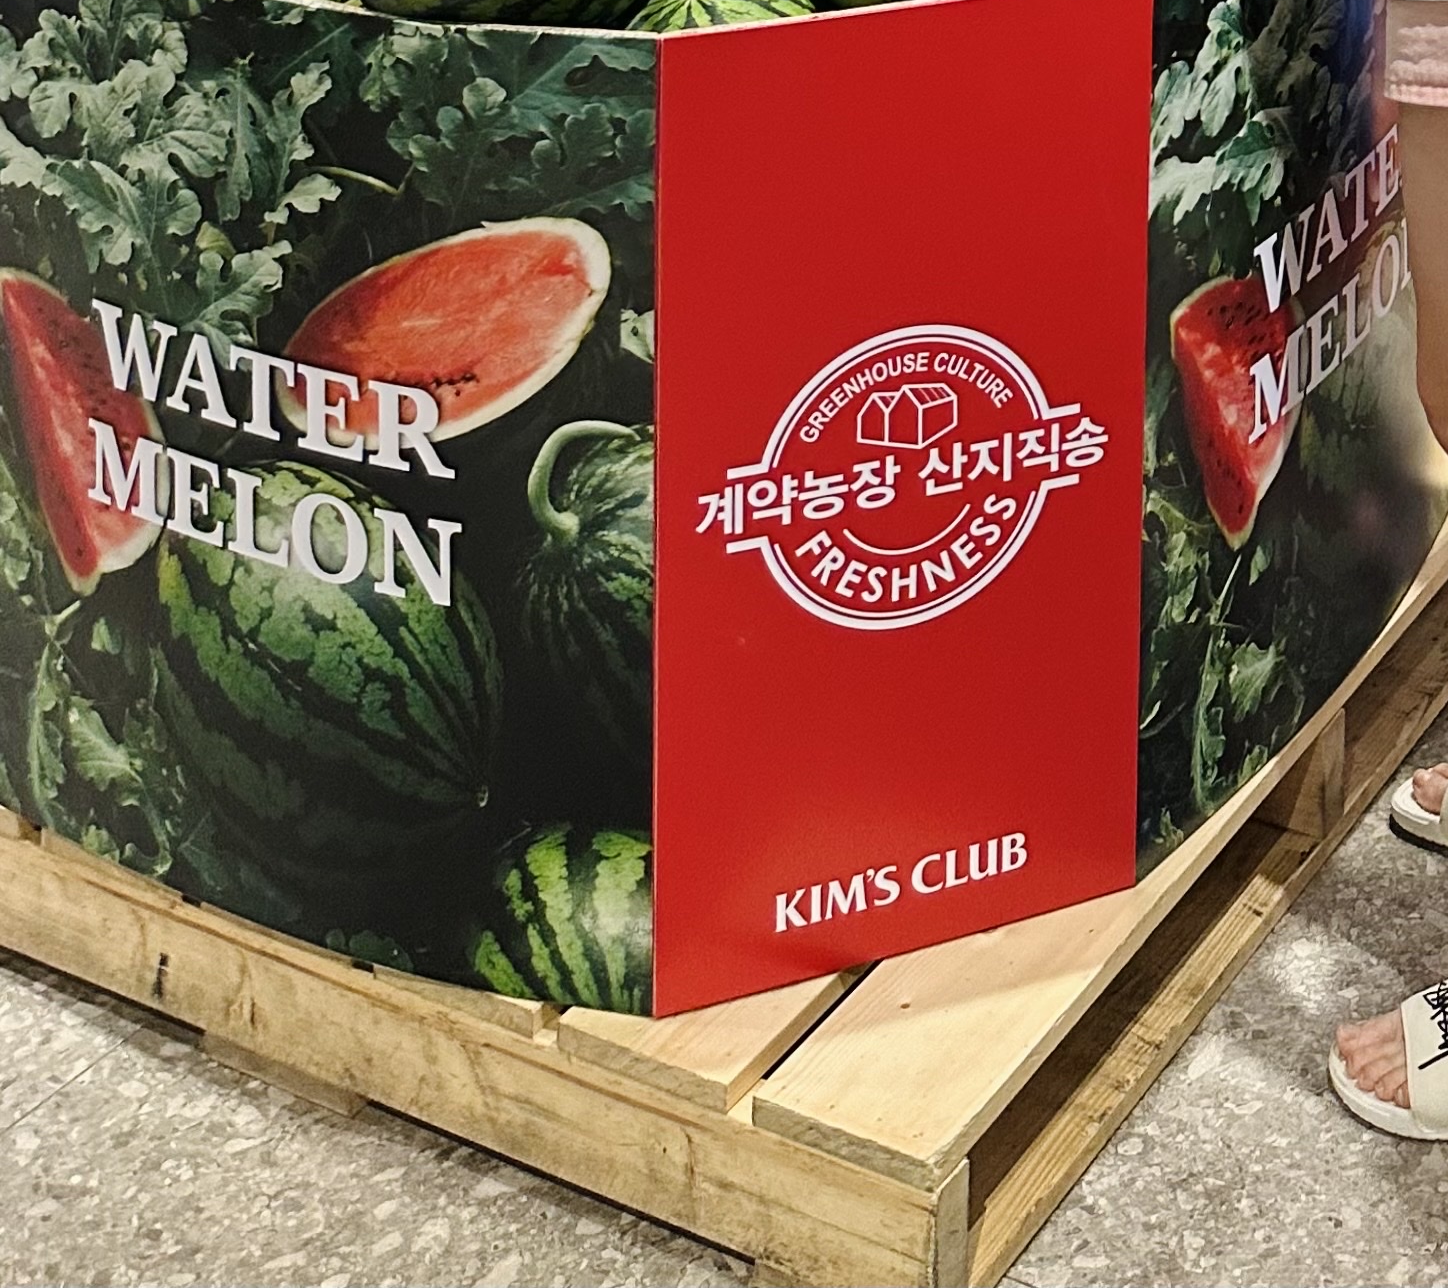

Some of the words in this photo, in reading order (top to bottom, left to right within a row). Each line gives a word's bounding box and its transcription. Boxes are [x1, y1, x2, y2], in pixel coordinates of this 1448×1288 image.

[1254, 124, 1399, 314] WATE
[92, 298, 455, 480] WATER
[799, 351, 930, 443] GREENHOUSE
[933, 351, 1013, 409] CULTURE
[87, 418, 462, 606] MELON
[696, 453, 902, 536] 계약농장
[918, 415, 1109, 498] 산지직송
[794, 493, 1017, 603] FRESHNESS
[773, 865, 902, 933] KIM'S
[909, 830, 1029, 895] CLUB
